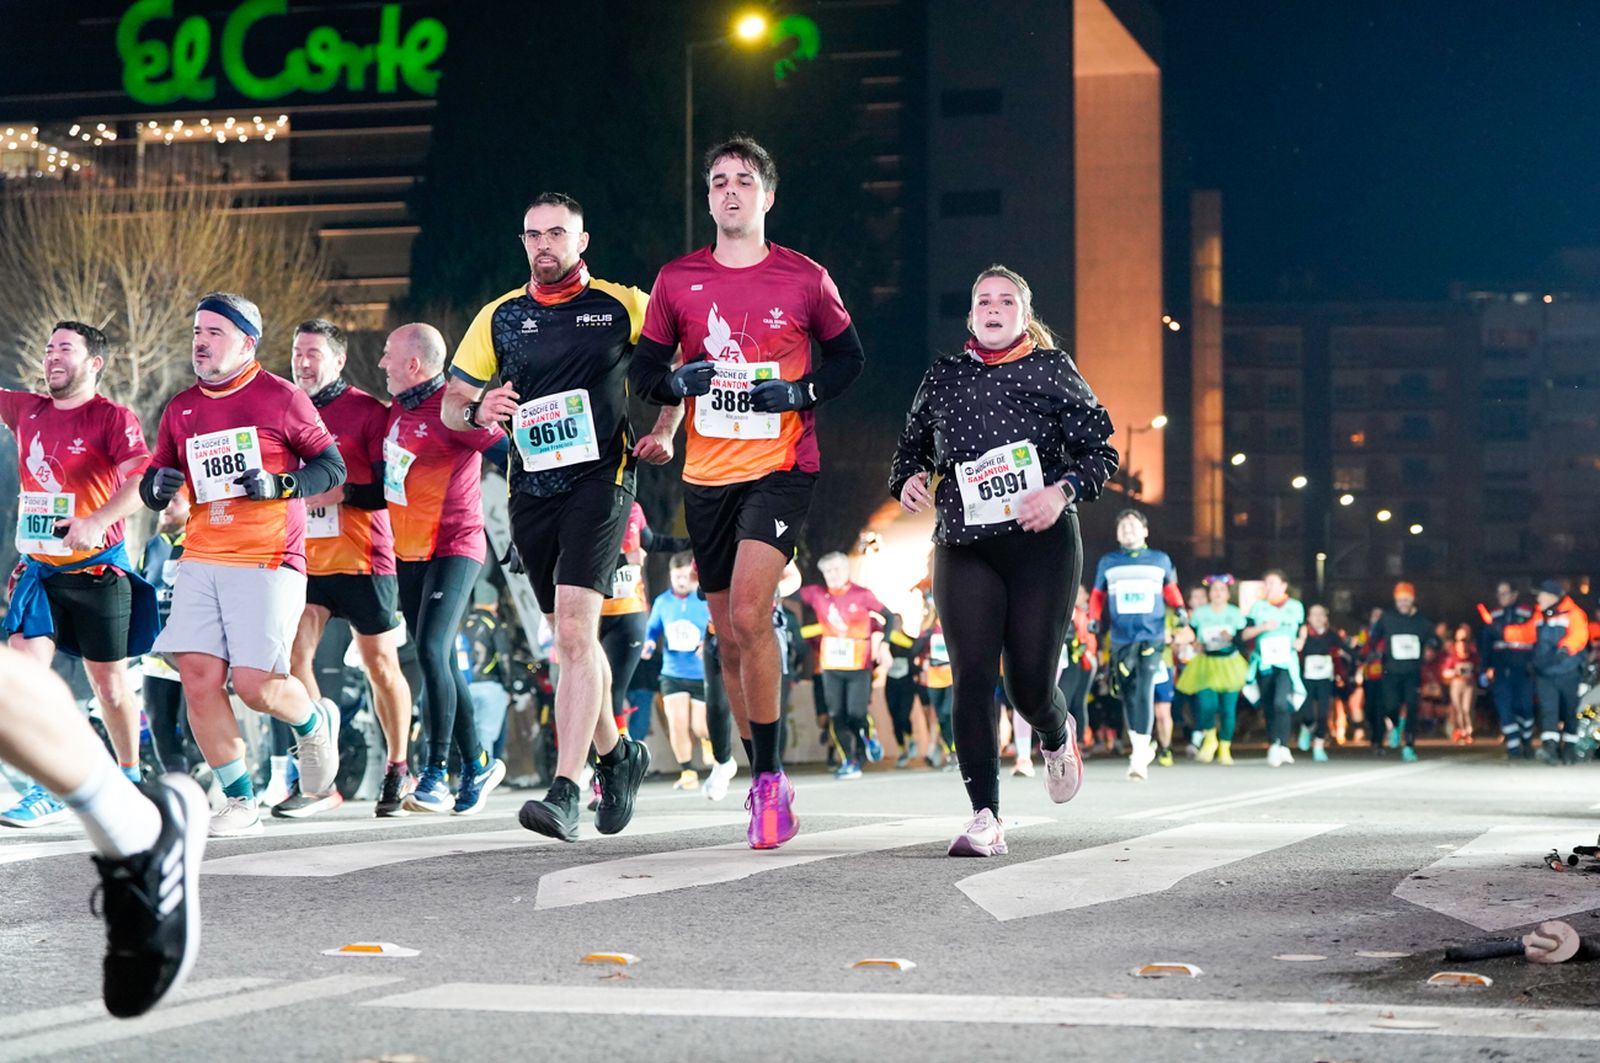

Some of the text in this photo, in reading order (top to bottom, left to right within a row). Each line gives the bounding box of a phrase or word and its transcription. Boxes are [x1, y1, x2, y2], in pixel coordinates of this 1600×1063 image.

[116, 0, 447, 105] El Corte
[576, 313, 612, 323] FOCUS
[711, 379, 721, 387] AN
[711, 388, 758, 413] 388
[529, 404, 548, 417] NOCHE
[549, 402, 559, 411] DE
[521, 418, 537, 428] SAN
[529, 417, 578, 447] 9610
[201, 437, 230, 449] NOCHE DE
[195, 450, 208, 460] SAN
[202, 452, 247, 478] 1888
[975, 459, 995, 474] NOCHE
[996, 455, 1006, 463] DE
[36, 466, 50, 482] 43
[967, 473, 984, 483] SAN
[978, 469, 1027, 501] 6991
